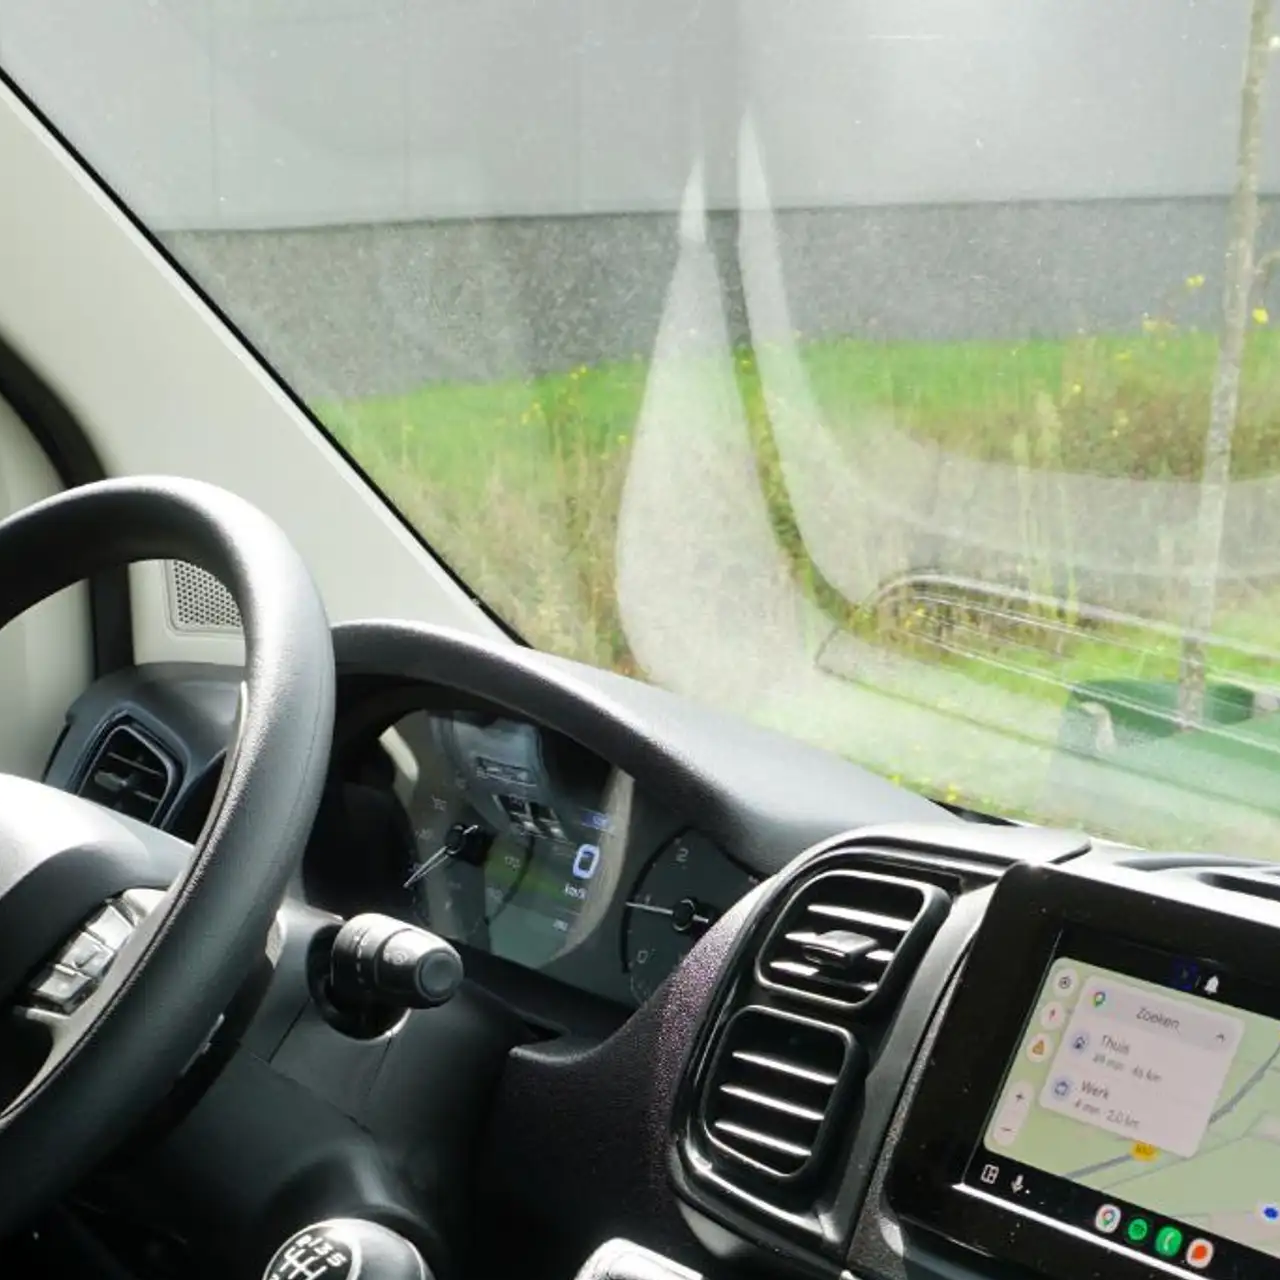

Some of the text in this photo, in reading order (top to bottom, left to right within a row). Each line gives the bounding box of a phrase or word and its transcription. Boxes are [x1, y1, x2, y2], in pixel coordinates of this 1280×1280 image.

[572, 843, 600, 880] 0
[1136, 1007, 1180, 1030] Zoeken
[1101, 1034, 1130, 1054] Thuis
[1081, 1080, 1109, 1100] Werk
